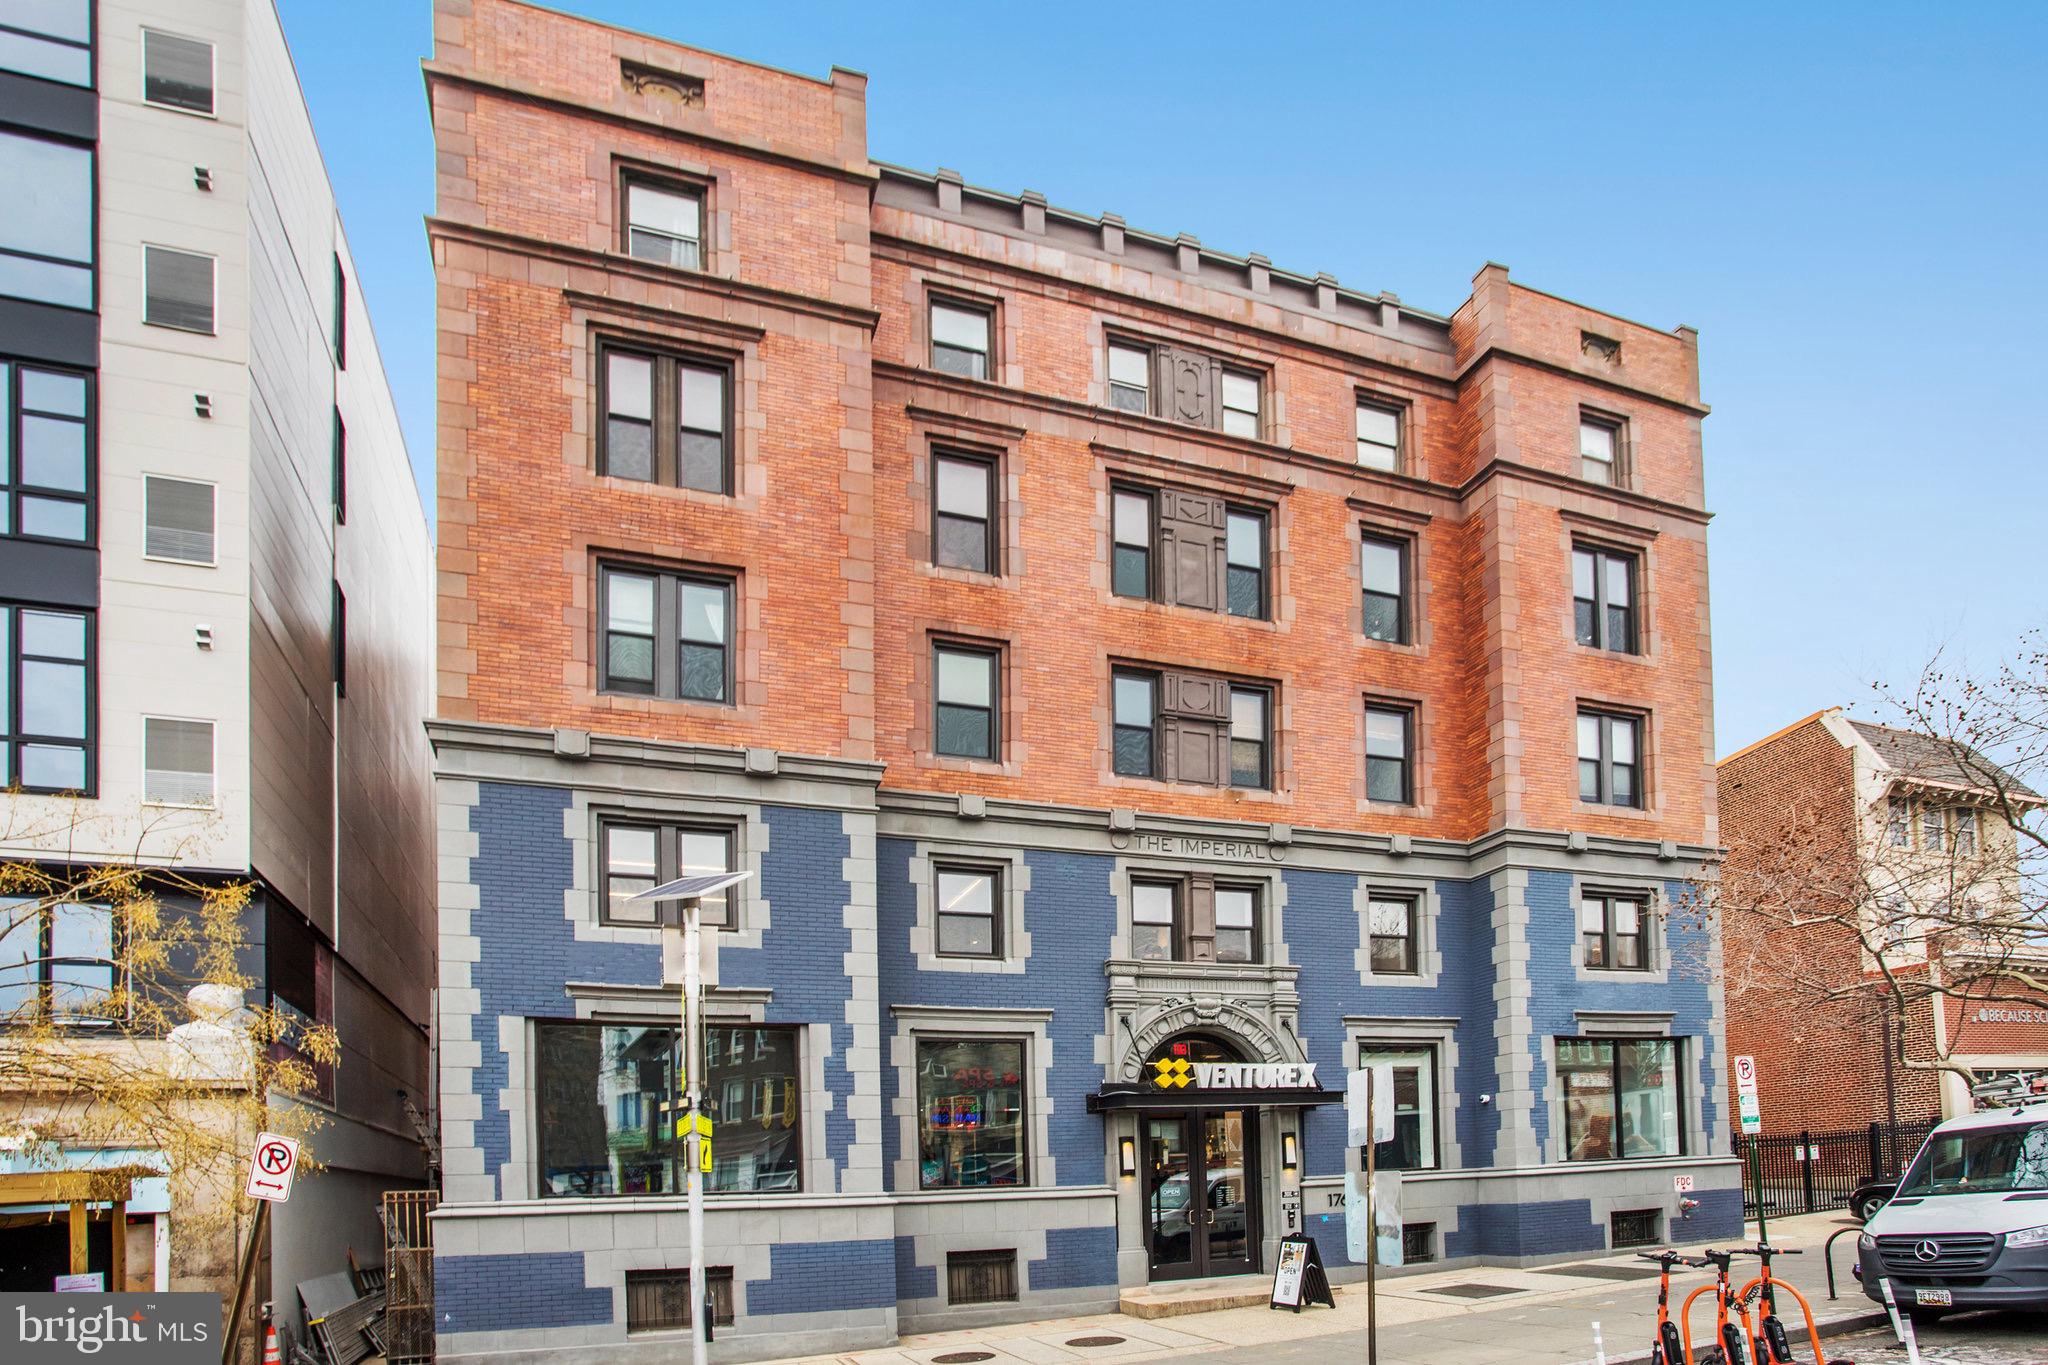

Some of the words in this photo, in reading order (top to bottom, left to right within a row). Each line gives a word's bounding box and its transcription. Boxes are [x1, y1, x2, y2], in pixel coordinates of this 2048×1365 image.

[1134, 834, 1173, 852] THE
[1180, 839, 1266, 860] IMPERIAL
[1988, 1009, 2032, 1022] BECAUSE
[1676, 1176, 1691, 1186] FDC
[1162, 1188, 1180, 1196] OPEN
